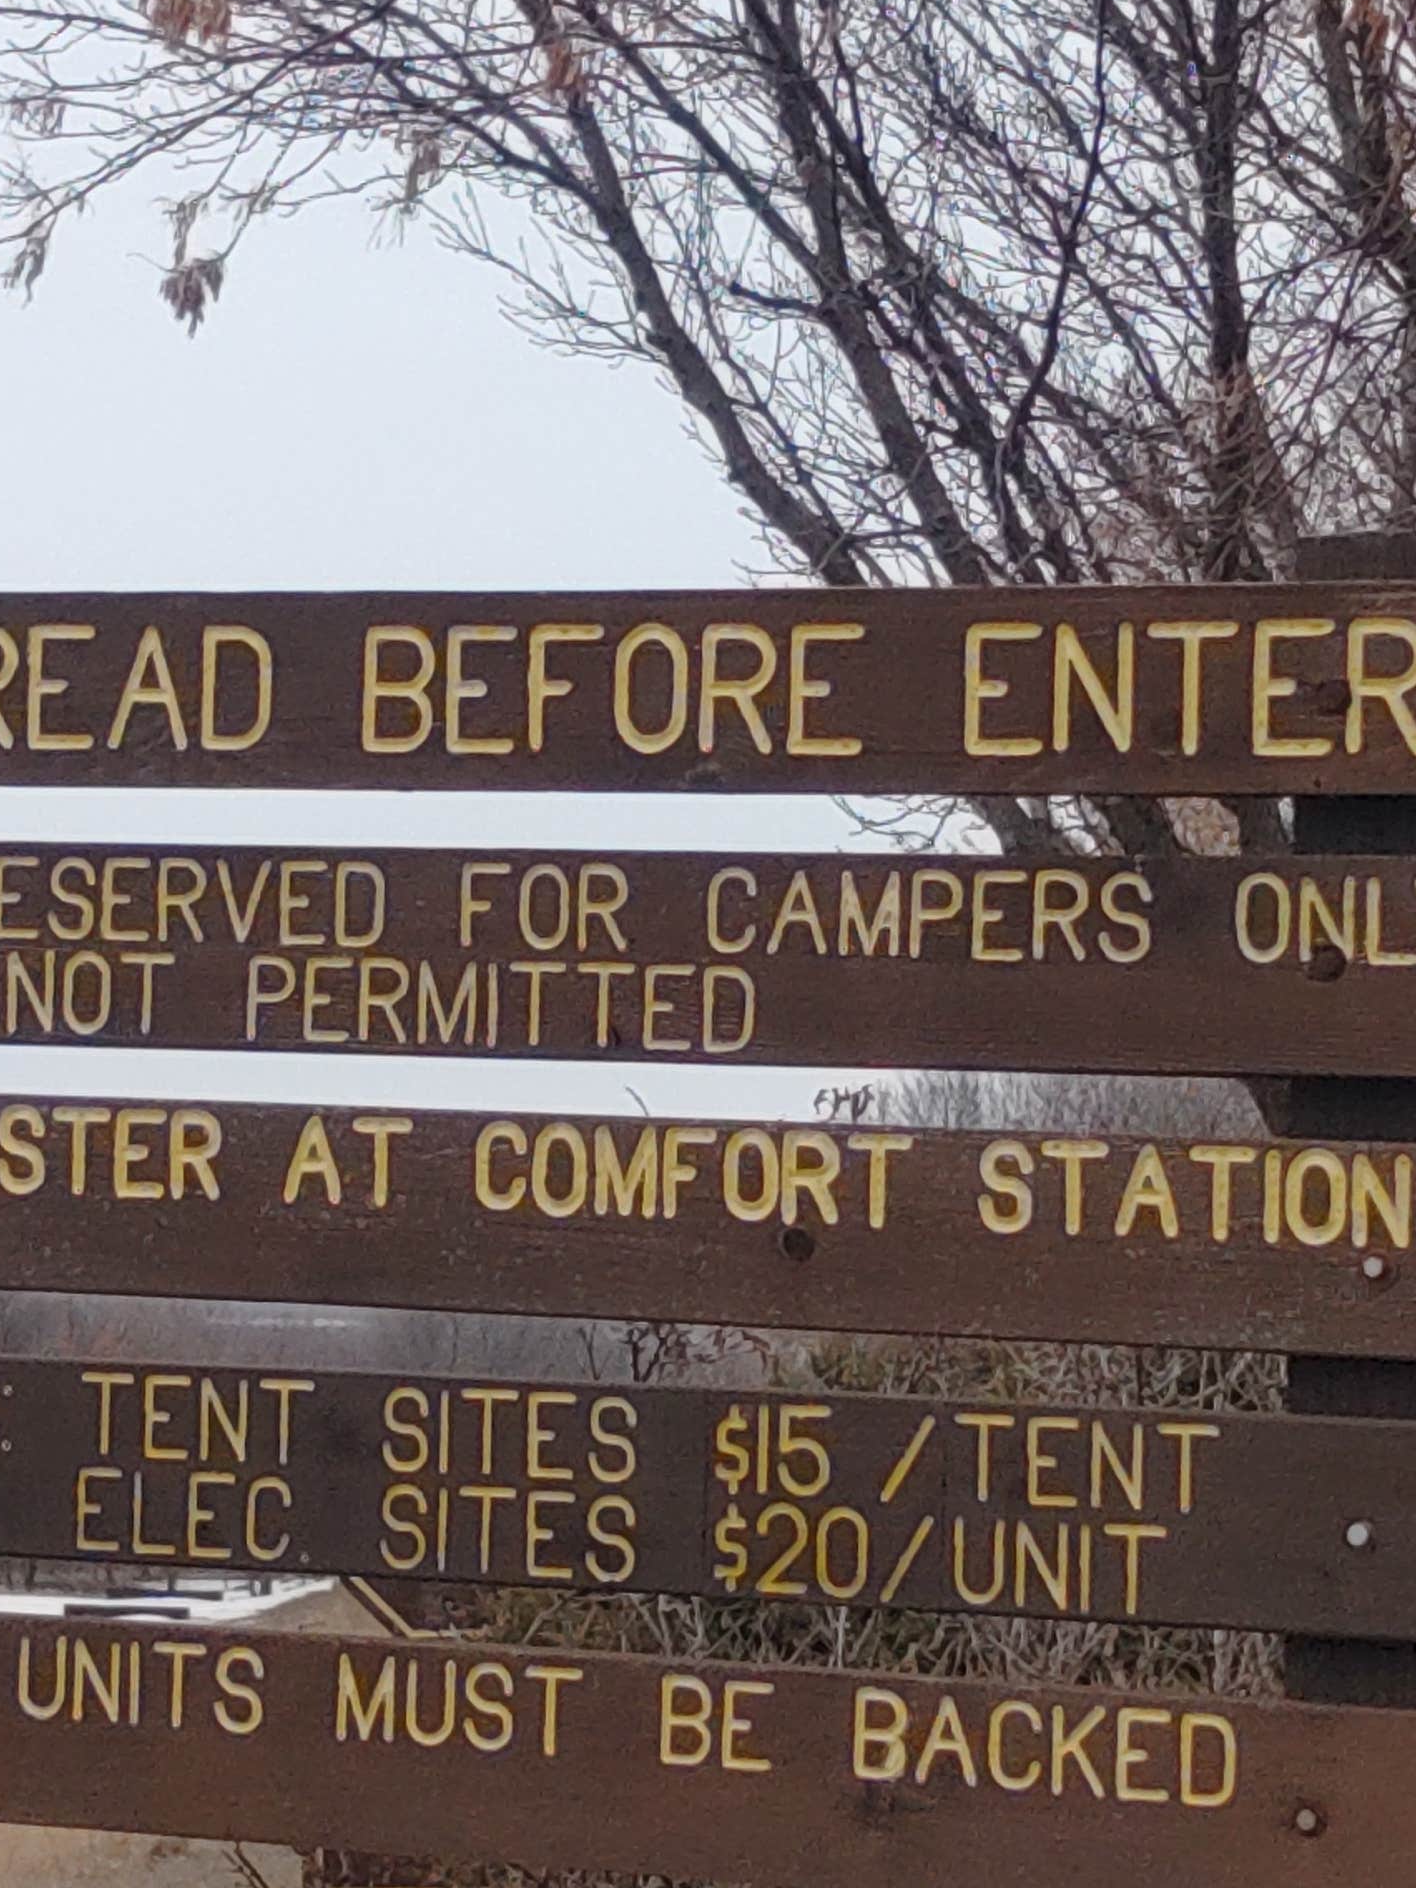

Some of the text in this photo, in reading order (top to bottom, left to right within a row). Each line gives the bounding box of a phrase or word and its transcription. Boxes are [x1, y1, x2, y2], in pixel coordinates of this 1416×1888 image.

[360, 621, 866, 757] BEFORE
[459, 861, 630, 953] FOR
[706, 867, 1152, 964] CAMPERS
[5, 948, 177, 1035] NOT
[245, 954, 756, 1055] PERMITTED
[282, 1114, 415, 1209] AT
[474, 1122, 914, 1230] COMFORT
[976, 1137, 1414, 1250] STATION
[80, 1371, 314, 1464] TENT
[381, 1386, 638, 1484] SITES
[380, 1483, 637, 1584] SITES
[17, 1634, 266, 1735] UNITS
[335, 1652, 585, 1758] MUST
[659, 1672, 776, 1773] BE
[852, 1684, 1238, 1808] BACKED
